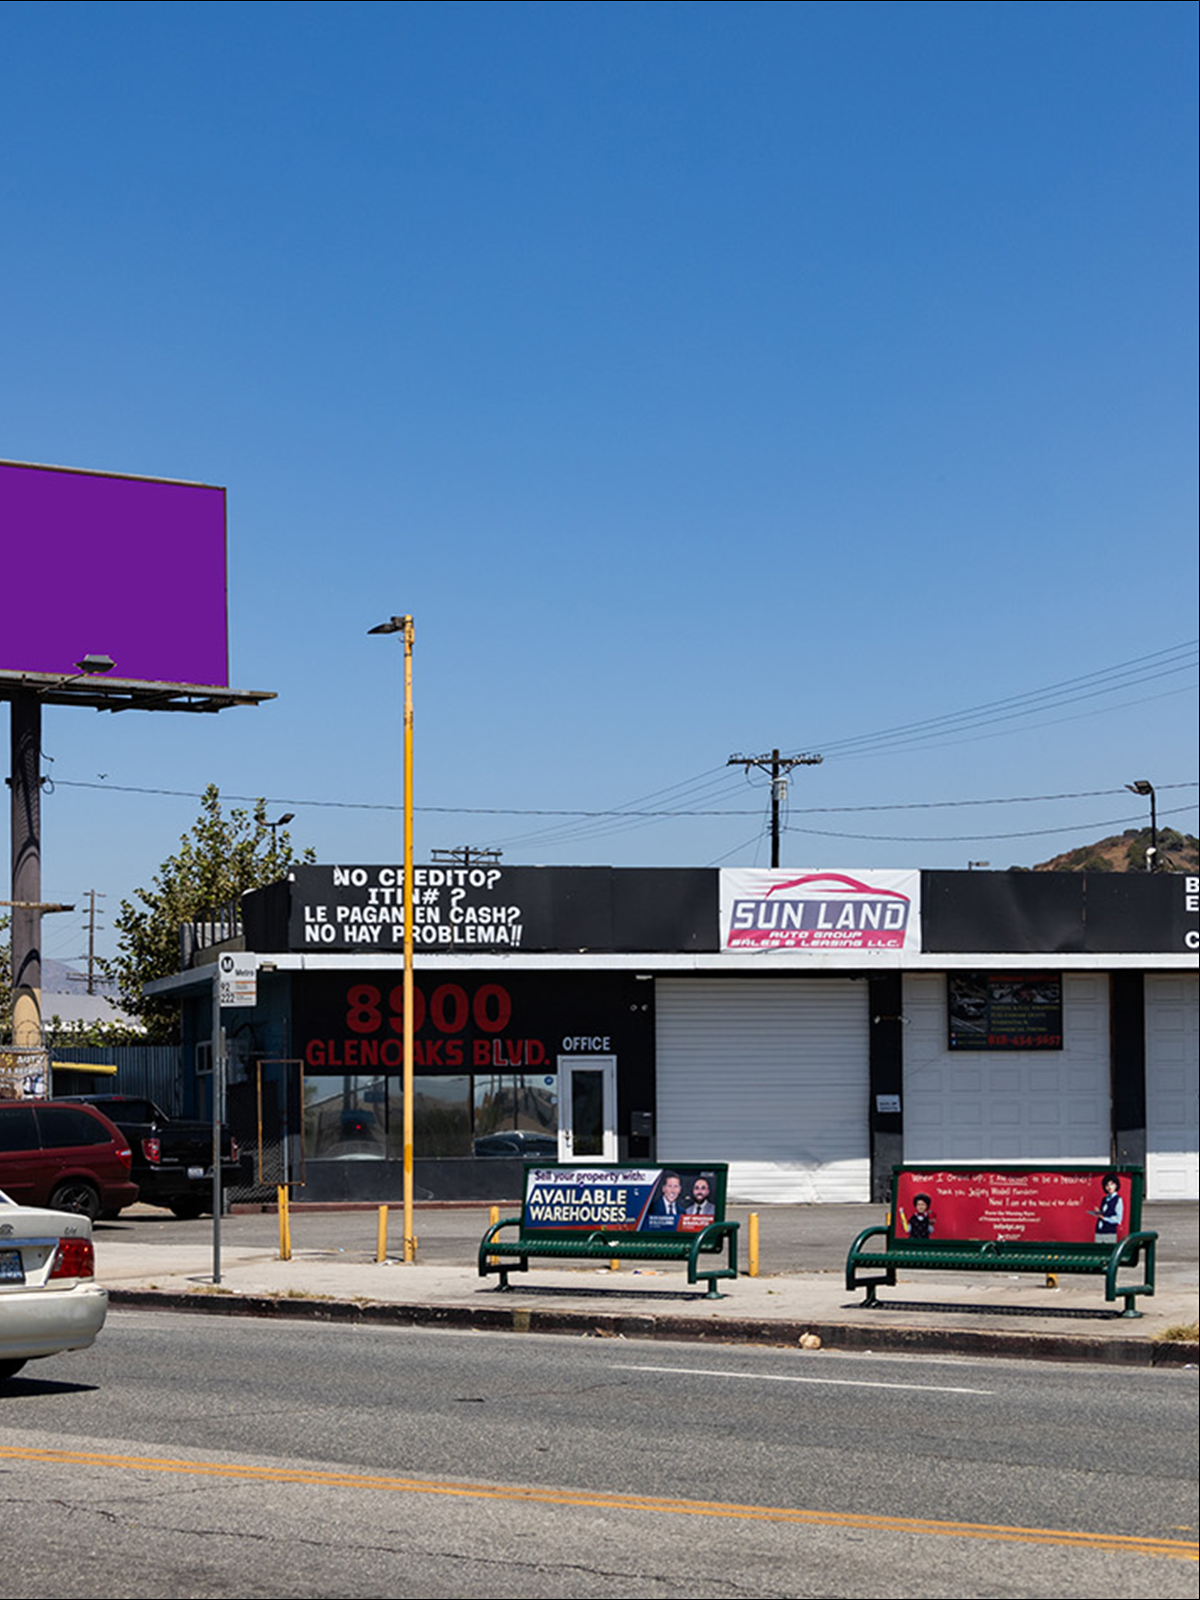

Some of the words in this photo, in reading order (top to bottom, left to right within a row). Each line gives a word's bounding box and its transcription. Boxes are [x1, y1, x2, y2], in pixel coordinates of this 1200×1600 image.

[334, 868, 368, 886] NO
[304, 906, 327, 922] LE
[337, 906, 406, 923] PAGAN
[416, 906, 440, 923] EN
[449, 906, 520, 926] CASH?
[734, 902, 804, 929] SUN
[817, 903, 905, 929] LAND
[305, 925, 335, 943] NO
[344, 925, 382, 943] HAY
[393, 925, 522, 946] PROBLEMA!!
[730, 938, 781, 947] SALES
[801, 939, 862, 947] LEASING
[867, 939, 900, 947] LLC.
[235, 969, 255, 977] Metro
[346, 983, 512, 1034] 8900
[562, 1036, 611, 1051] OFFICE
[305, 1039, 464, 1067] GLENOAKS
[473, 1039, 551, 1067] BLVD.
[534, 1170, 552, 1181] Sell
[554, 1172, 574, 1182] your
[576, 1171, 619, 1182] property
[623, 1170, 646, 1181] with:
[530, 1188, 628, 1205] AVAILABLE
